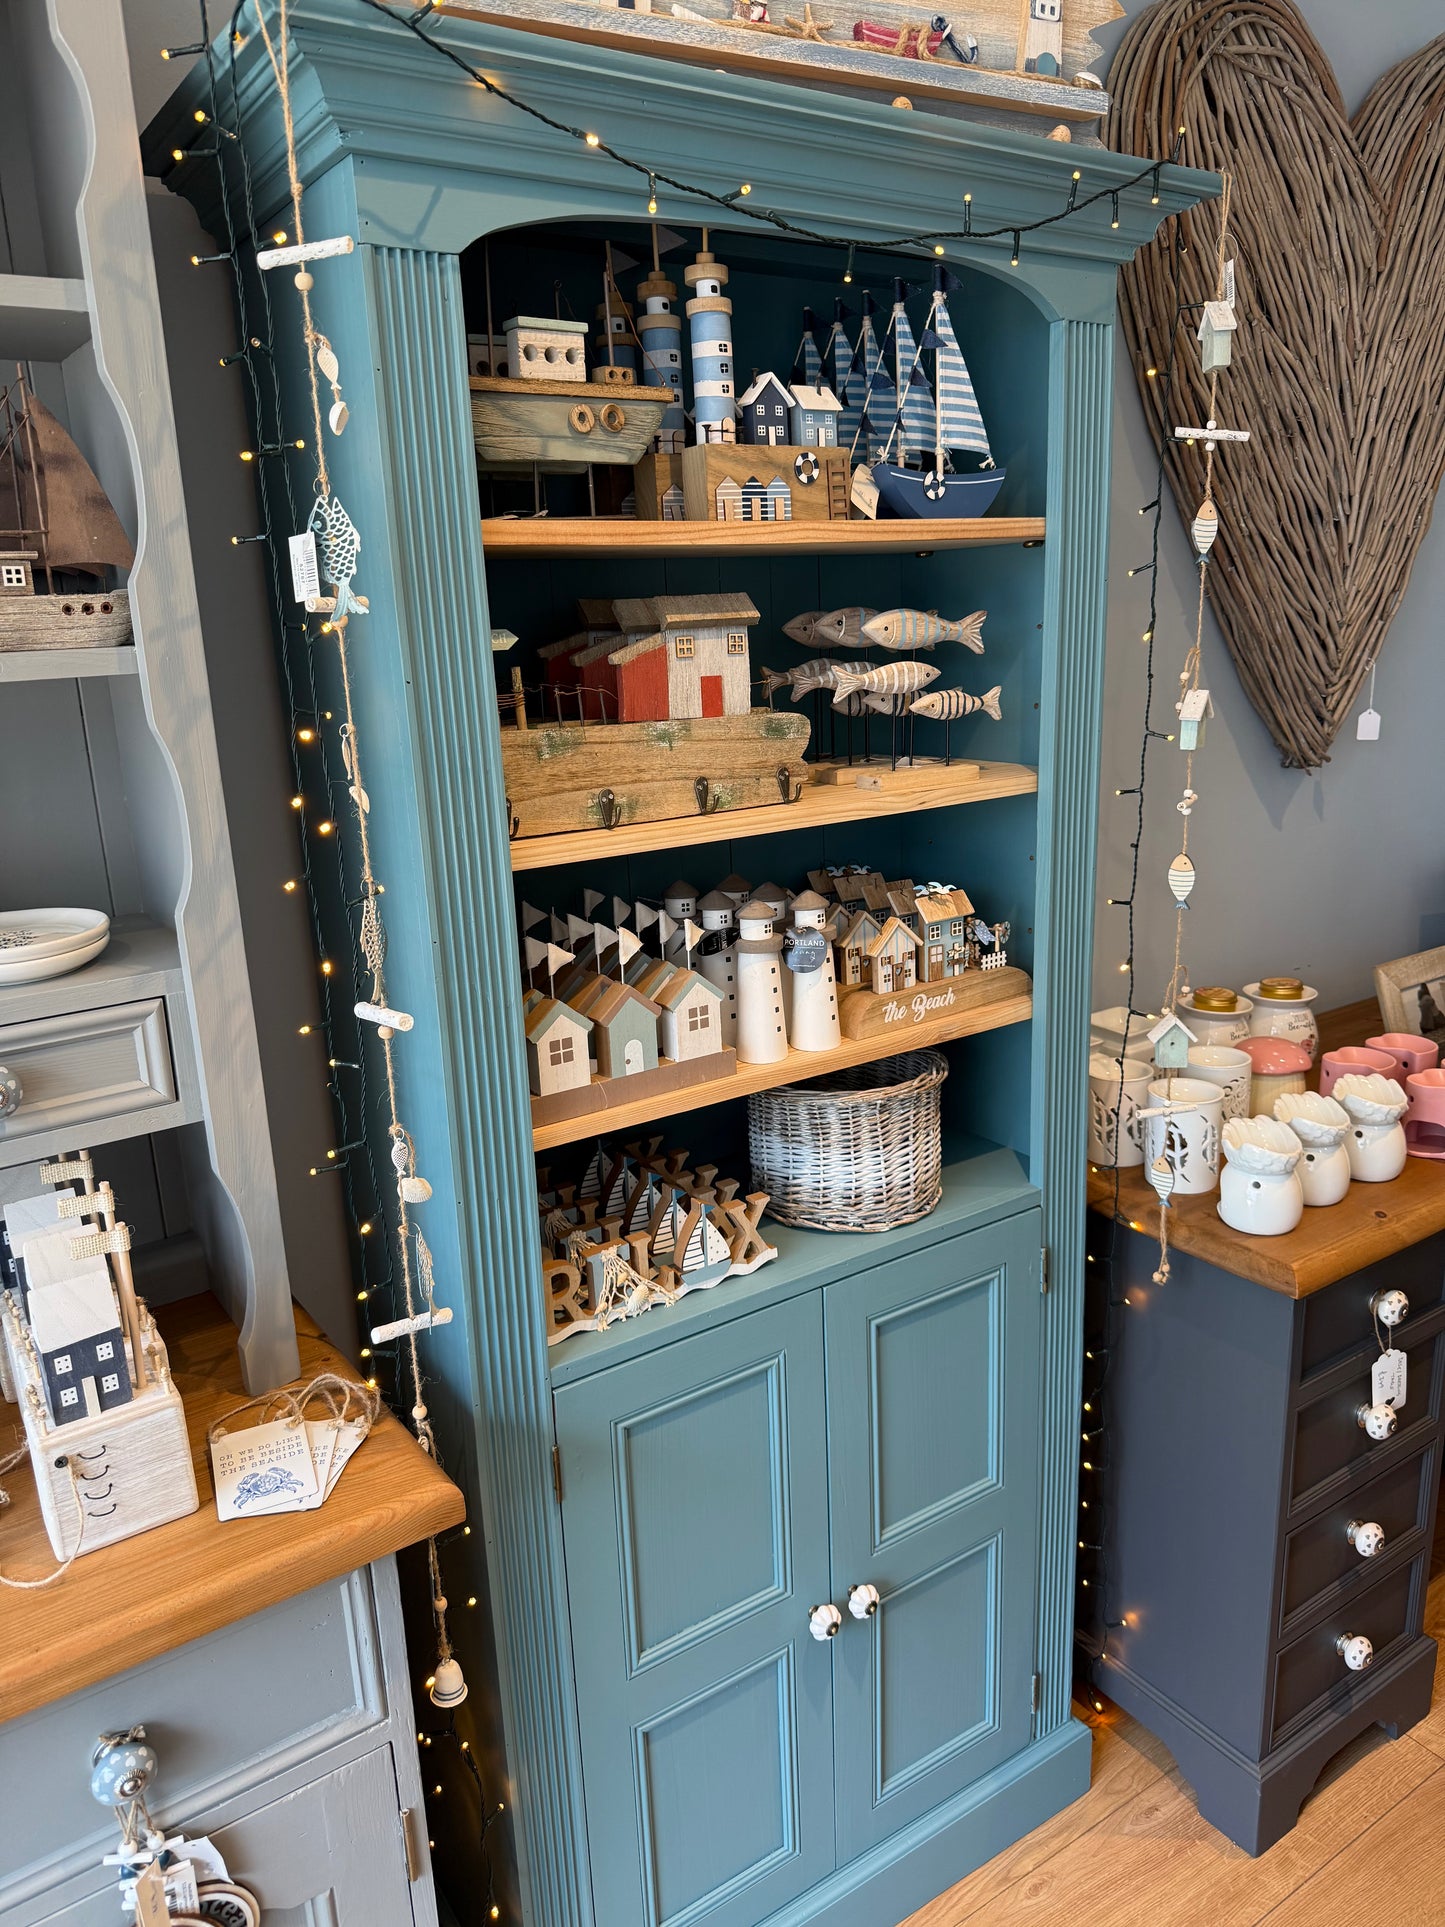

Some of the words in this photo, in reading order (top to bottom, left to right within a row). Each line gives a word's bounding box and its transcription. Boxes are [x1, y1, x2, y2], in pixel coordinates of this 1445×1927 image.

[784, 939, 825, 947] PORTLAND
[882, 1000, 907, 1023] the
[911, 986, 956, 1023] Beach
[219, 1453, 233, 1462] OH
[238, 1448, 254, 1456] WE
[257, 1443, 271, 1451] DO
[275, 1434, 301, 1446] LIKE
[219, 1460, 235, 1469] TO
[240, 1454, 255, 1463] BE
[260, 1441, 303, 1458] BESIDE
[220, 1464, 246, 1477] THE
[251, 1448, 304, 1468] SEASIDE
